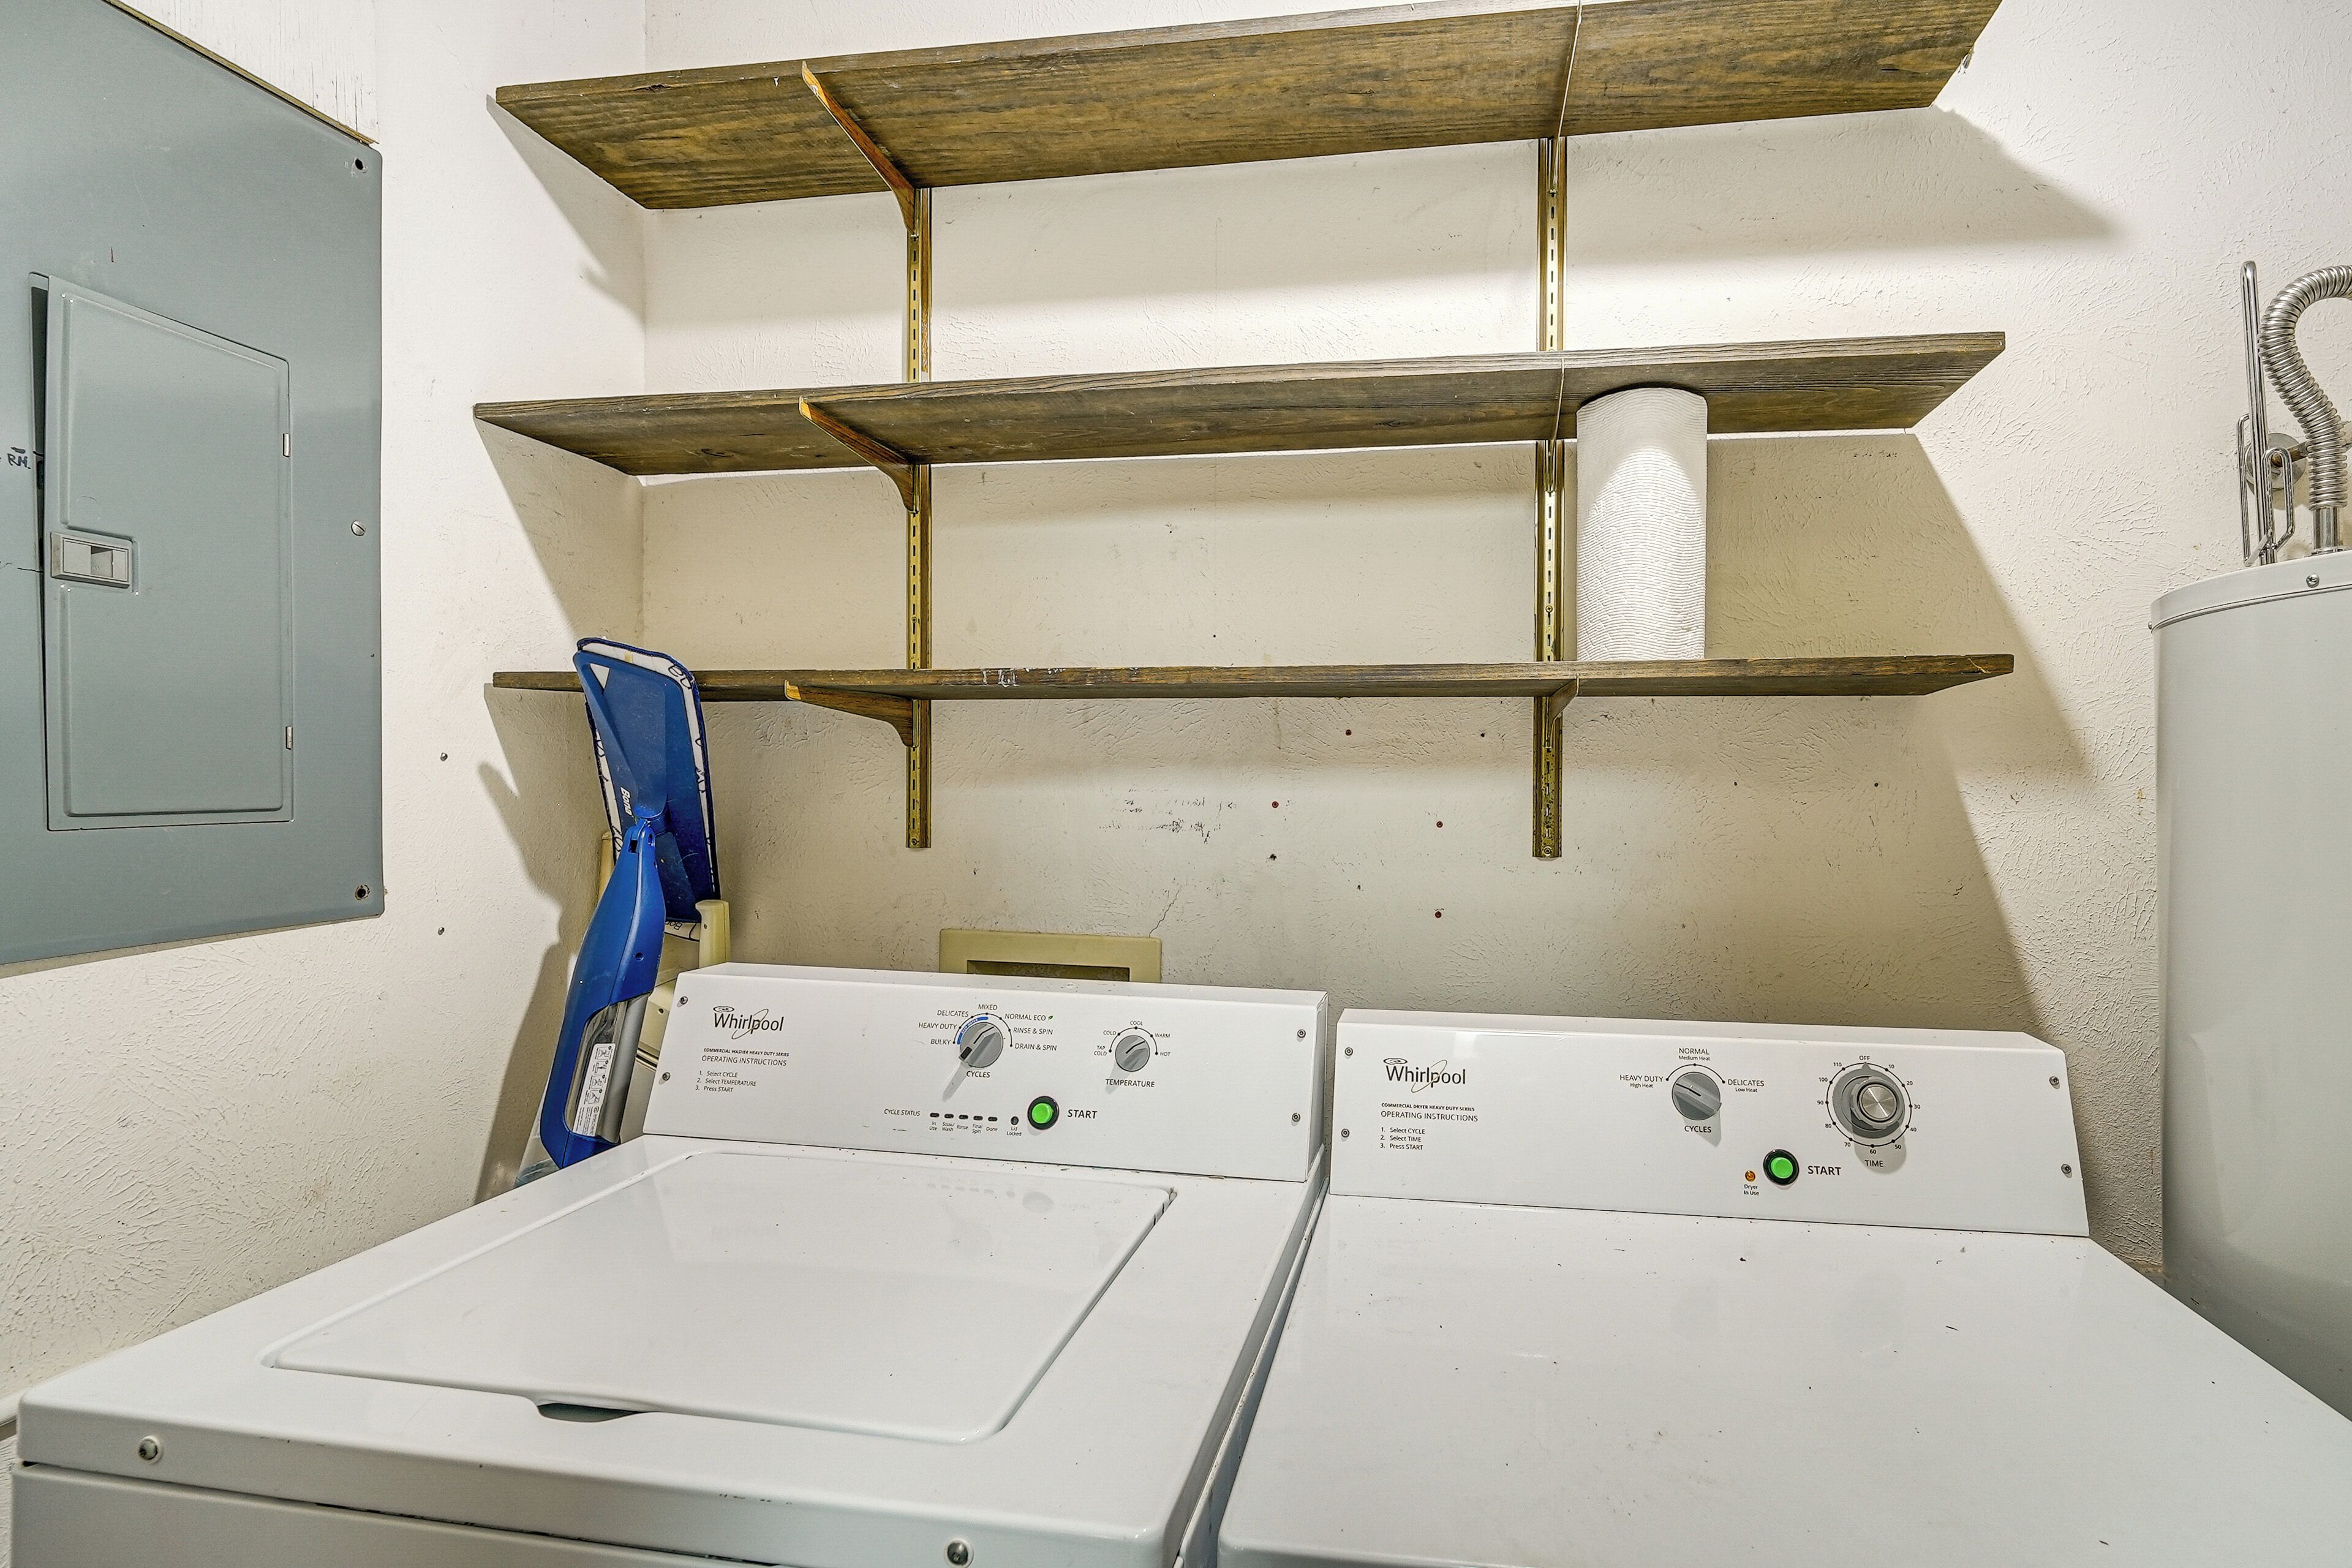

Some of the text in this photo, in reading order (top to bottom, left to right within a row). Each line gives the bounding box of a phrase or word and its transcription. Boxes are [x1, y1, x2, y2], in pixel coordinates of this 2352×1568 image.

[620, 787, 633, 816] Bona
[714, 1013, 784, 1034] Whirlpool
[739, 1058, 786, 1066] INSTRUCTIONS
[1385, 1066, 1466, 1088] Whirlpool
[1106, 1079, 1155, 1087] TEMPERATURE
[1068, 1109, 1098, 1119] START
[1424, 1113, 1478, 1121] INSTRUCTIONS
[1808, 1166, 1841, 1175] START
